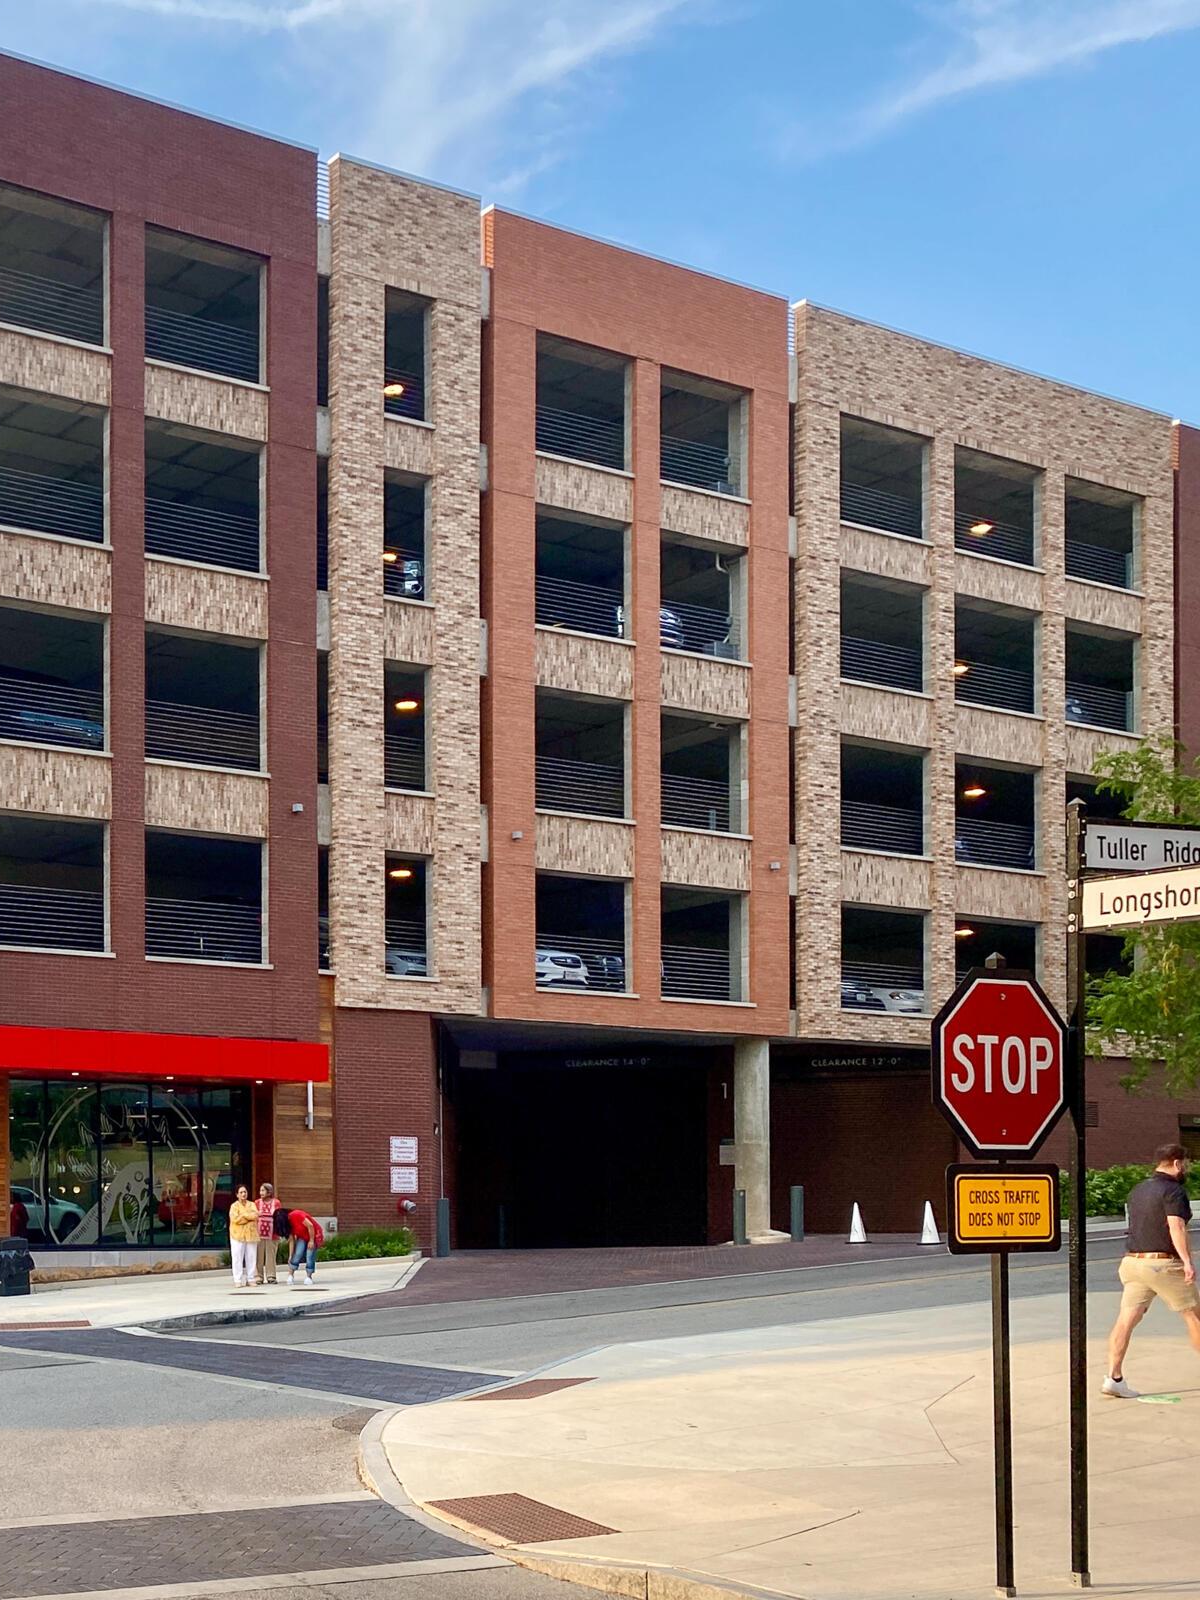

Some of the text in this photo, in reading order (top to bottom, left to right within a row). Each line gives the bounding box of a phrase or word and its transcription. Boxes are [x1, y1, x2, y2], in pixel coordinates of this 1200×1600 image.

[1097, 835, 1147, 861] Tuller
[565, 1058, 619, 1068] CLEARANCE
[811, 1058, 867, 1067] CLEARANCE
[951, 1033, 1054, 1095] STOP
[969, 1190, 1040, 1204] CROSS TRAFFIC
[968, 1212, 1041, 1227] DOES NOT STOP
